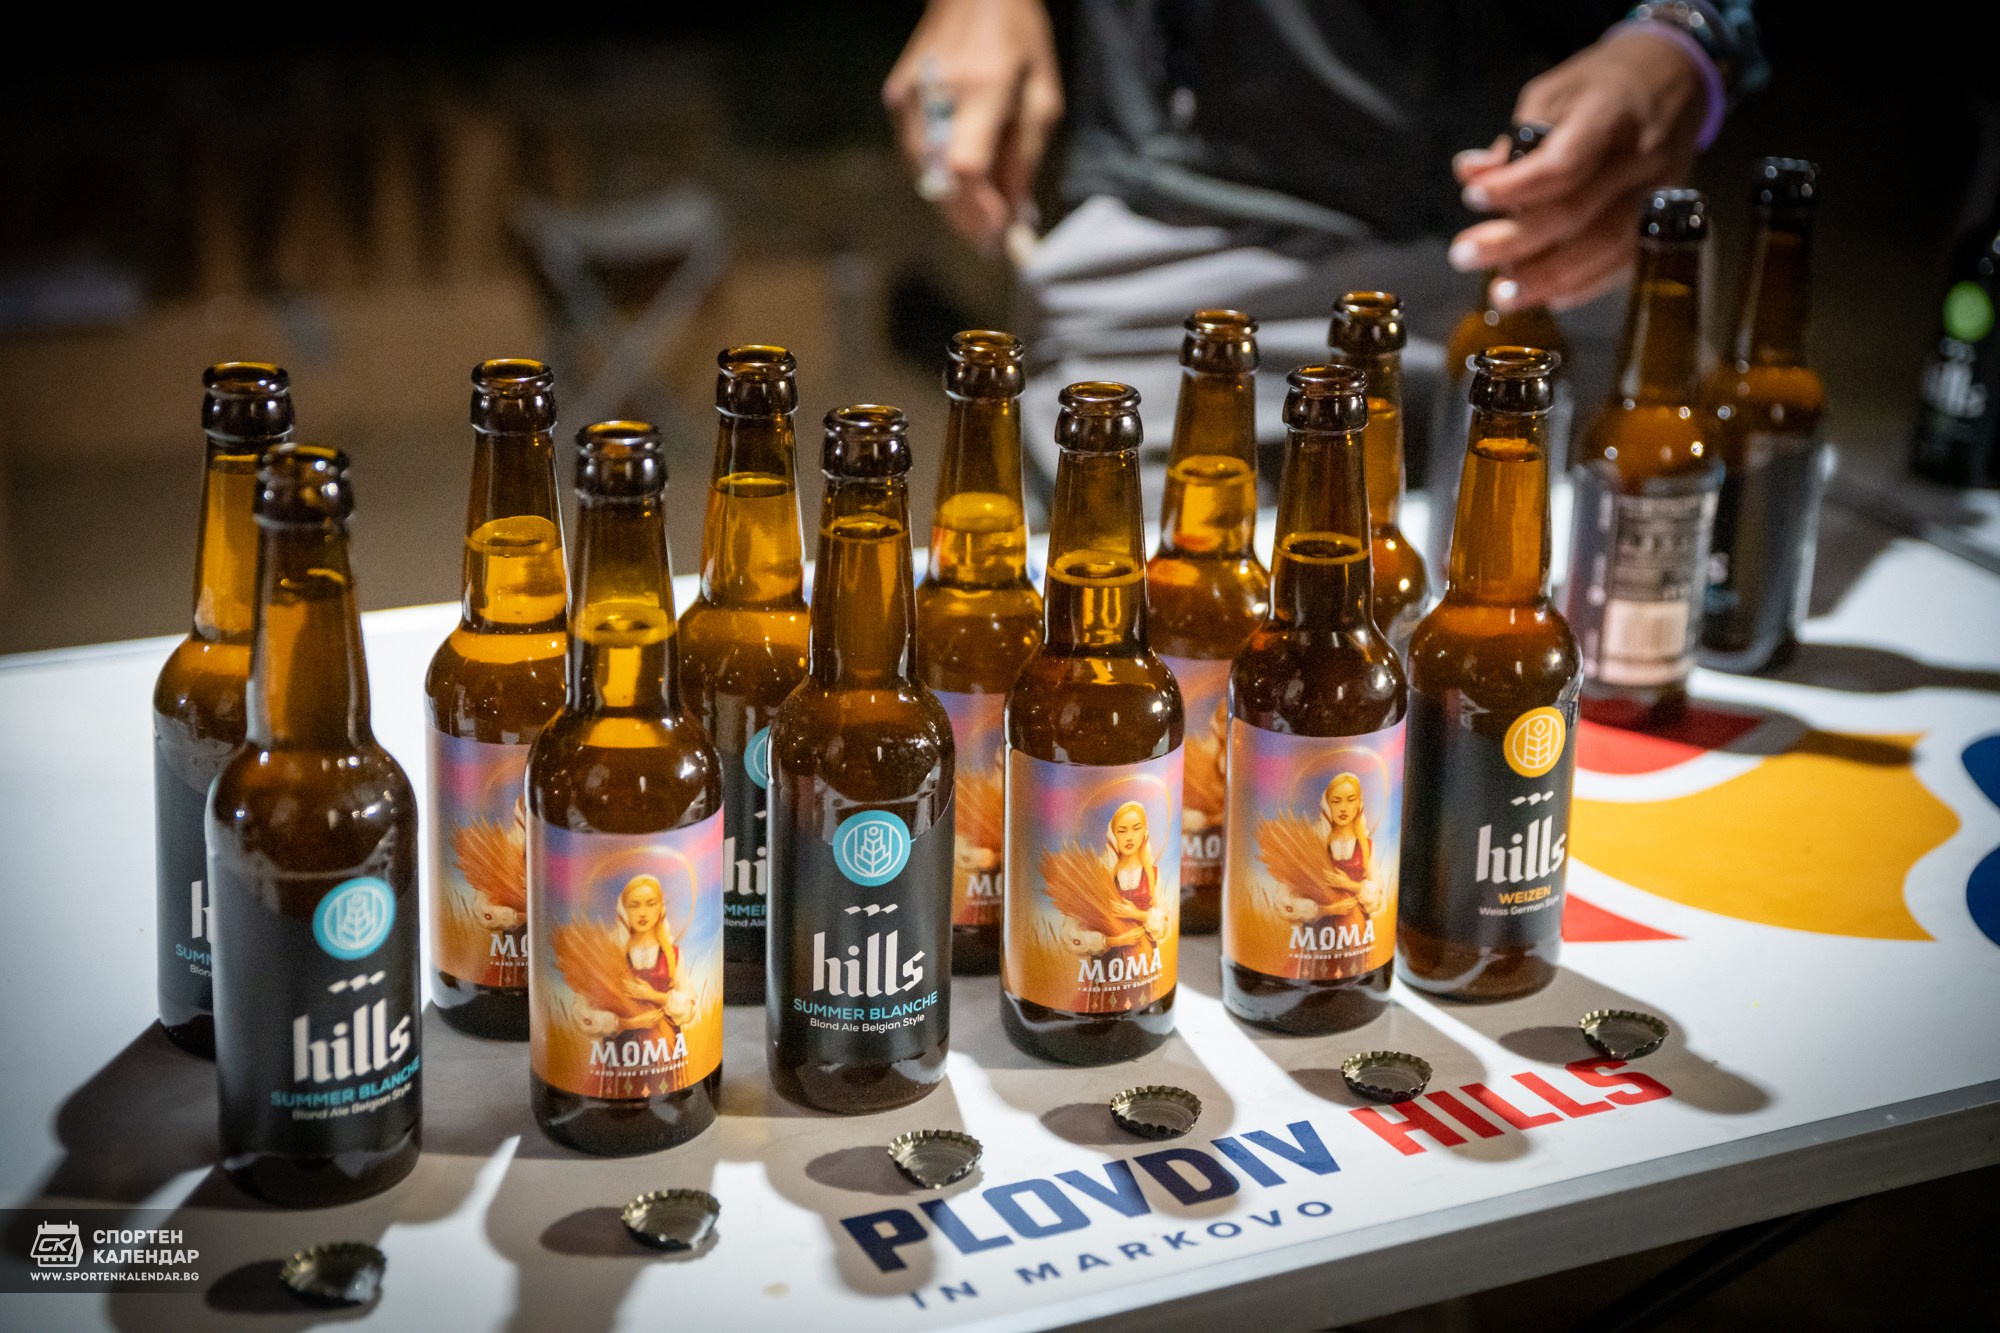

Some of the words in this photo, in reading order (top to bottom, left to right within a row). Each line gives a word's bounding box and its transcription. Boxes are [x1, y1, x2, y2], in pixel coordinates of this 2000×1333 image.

[1181, 834, 1221, 858] MO
[1476, 815, 1566, 884] hills
[1479, 907, 1508, 916] Weiss
[1511, 903, 1544, 915] German
[1499, 885, 1552, 904] WEIZEN
[723, 918, 748, 927] lond
[1289, 919, 1376, 951] MOMA
[189, 964, 212, 977] Blon
[813, 930, 925, 998] hills
[1077, 947, 1163, 983] MOMA
[793, 998, 865, 1020] SUMMER
[869, 990, 938, 1020] BLANCHE
[810, 1017, 839, 1031] Blond
[841, 1023, 859, 1032] Ale
[862, 1021, 900, 1034] Belgian
[902, 1013, 925, 1027] Style
[293, 998, 411, 1083] hills
[589, 1032, 689, 1068] MOMA
[270, 1087, 356, 1107] SUMMER
[358, 1054, 420, 1100] BLANCHE
[292, 1108, 327, 1121] Blond
[329, 1106, 350, 1118] Ale
[351, 1094, 391, 1114] Belgian
[839, 1120, 1342, 1274] PLOVDIV
[1348, 1057, 1673, 1156] HILLS
[910, 1281, 979, 1309] IN
[1015, 1201, 1334, 1284] MARKOVO
